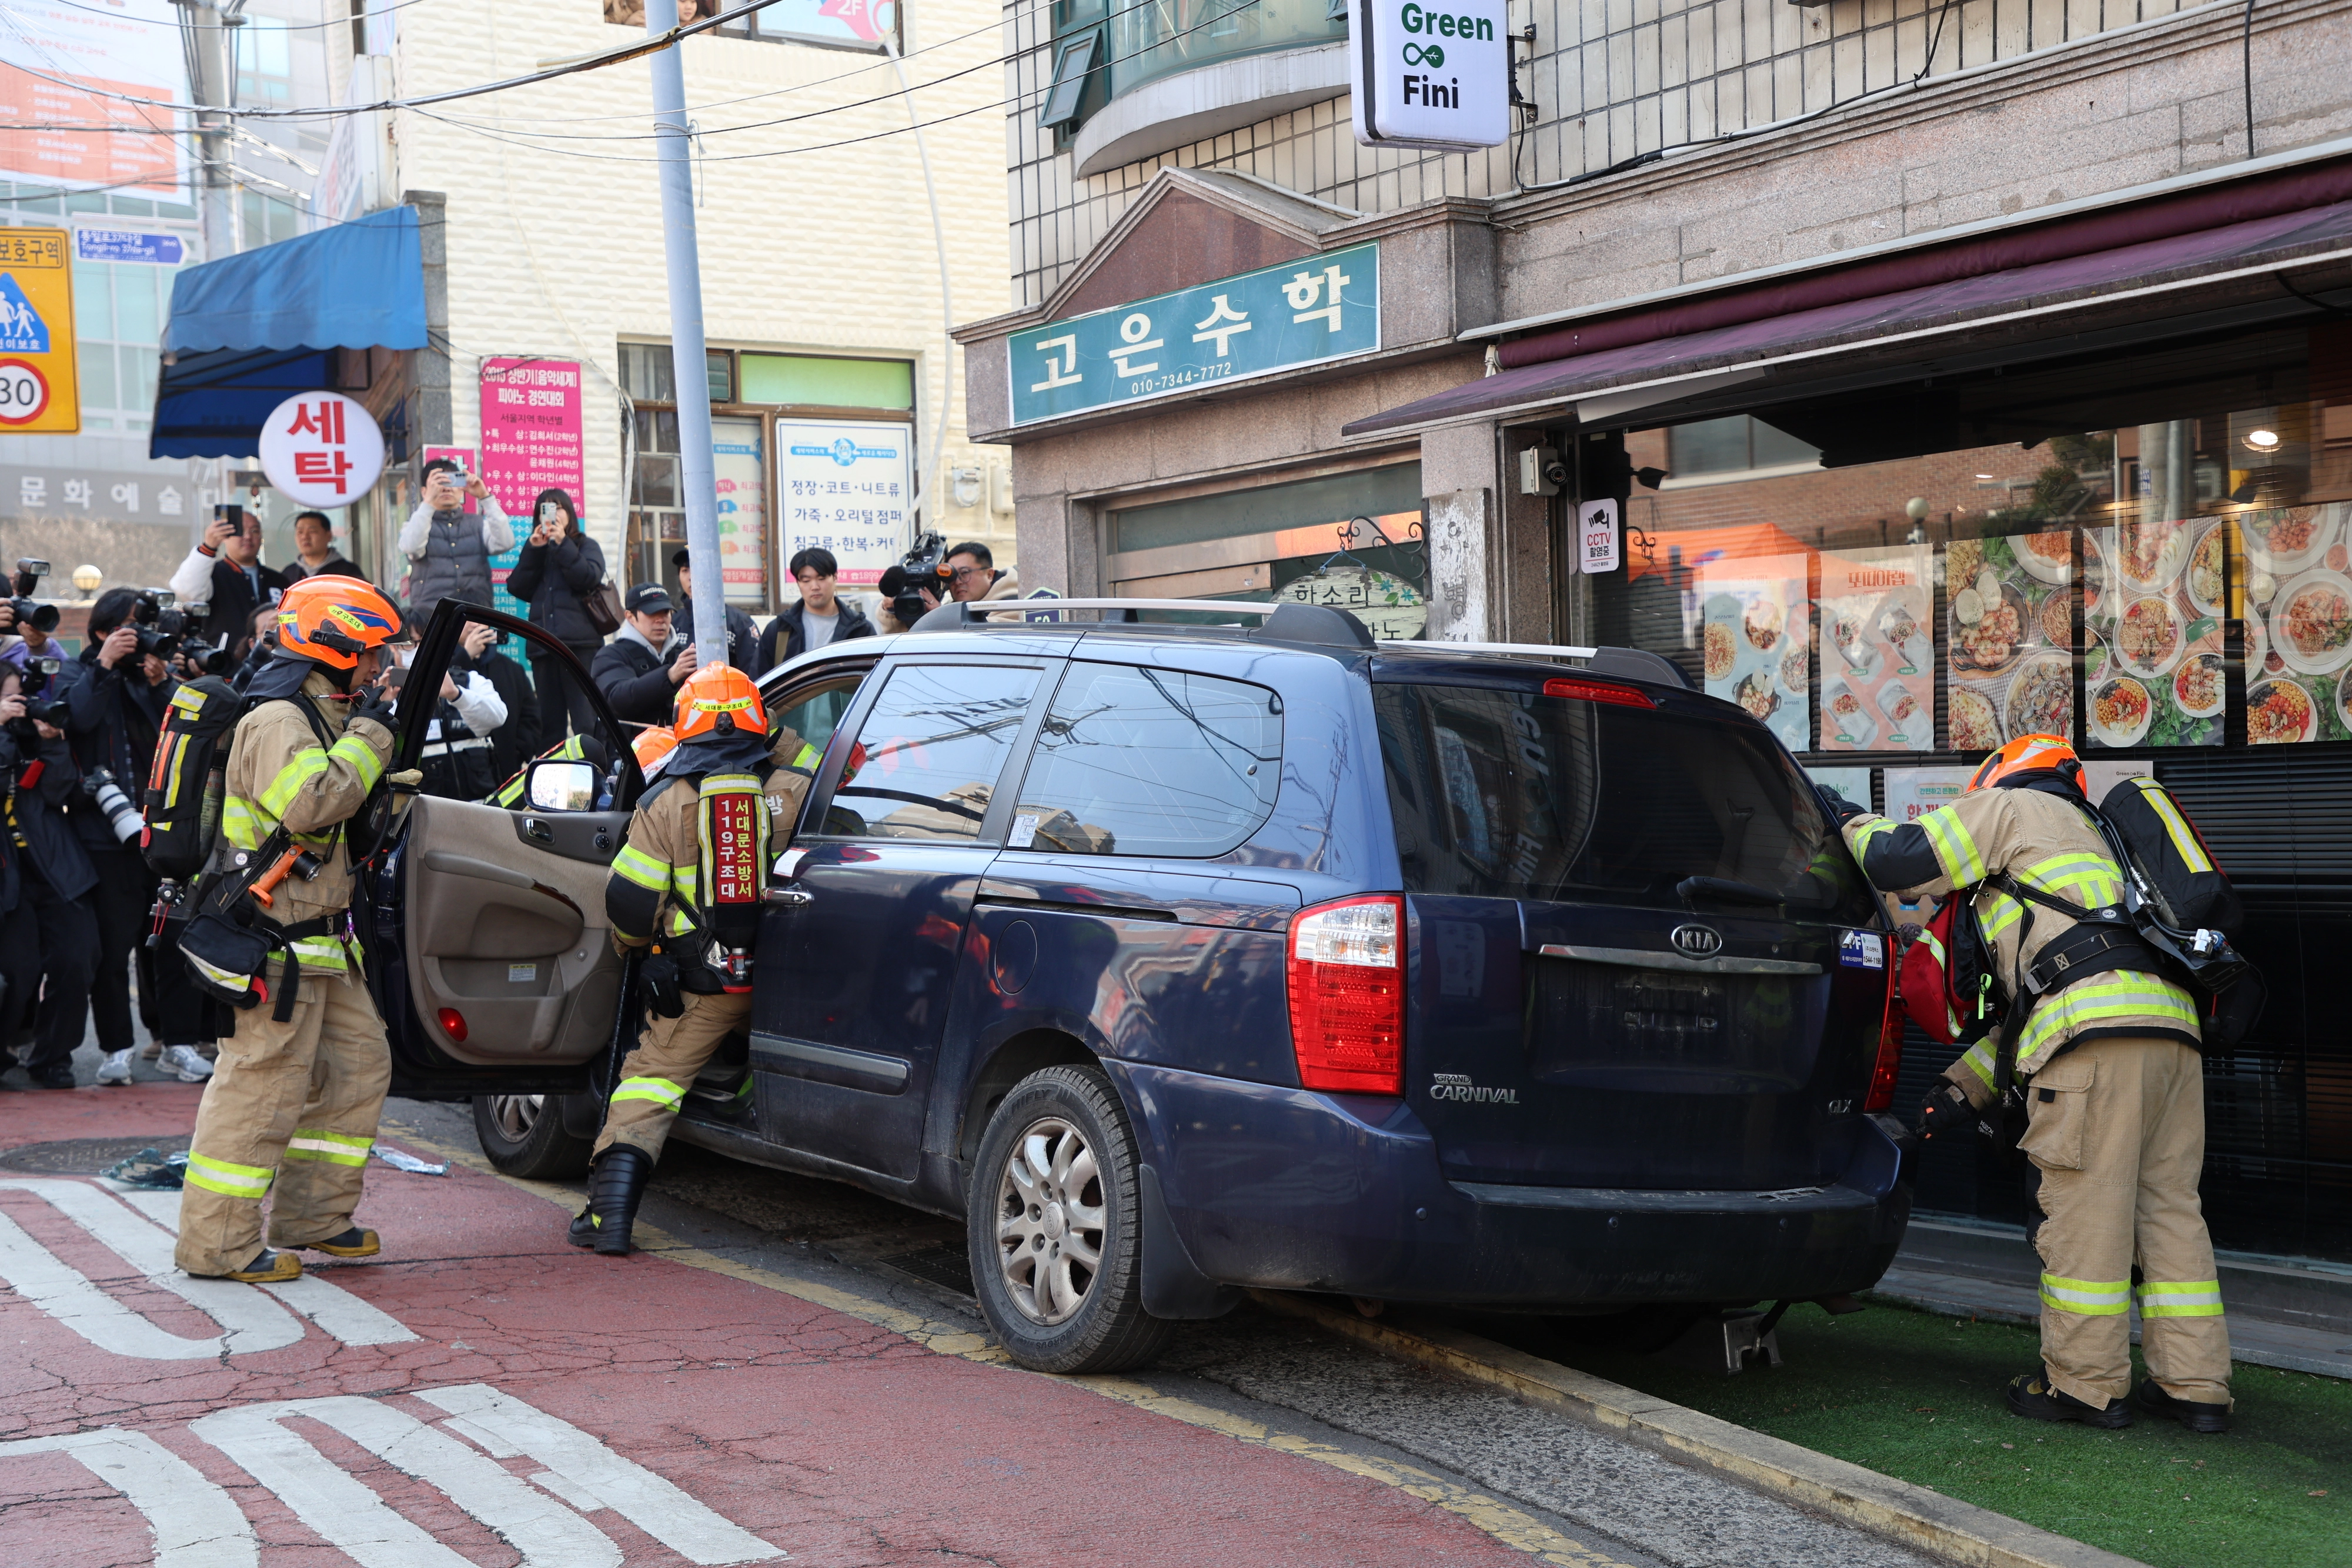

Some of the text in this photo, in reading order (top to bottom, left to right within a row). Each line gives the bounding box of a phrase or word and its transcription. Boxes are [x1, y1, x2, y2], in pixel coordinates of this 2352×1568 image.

[837, 0, 862, 15] 2F
[1401, 3, 1494, 41] Green
[1404, 75, 1459, 109] Fini
[1031, 265, 1351, 393] 고은수학
[485, 366, 506, 383] 2015
[1131, 362, 1232, 394] 010-7344-7772
[0, 377, 35, 406] 30
[497, 388, 564, 407] 피아노 경연대회
[500, 413, 563, 426] 서울지역 학년별
[286, 401, 353, 494] 세탁
[877, 510, 902, 524] 점퍼
[1587, 531, 1612, 546] CCTV
[1590, 546, 1609, 558] 촬영중
[1847, 569, 1906, 589] 또띠아랩
[343, 612, 362, 628] 구조대
[720, 800, 736, 898] 119구조대
[736, 800, 752, 898] 서대문소방서
[1681, 930, 1715, 951] KIA
[1863, 955, 1882, 965] 1544-1198
[1436, 1075, 1471, 1084] GRAND
[1429, 1084, 1521, 1105] CARNIVAL
[1828, 1099, 1852, 1114] GLX
[1035, 1322, 1081, 1350] VIGOROUS
